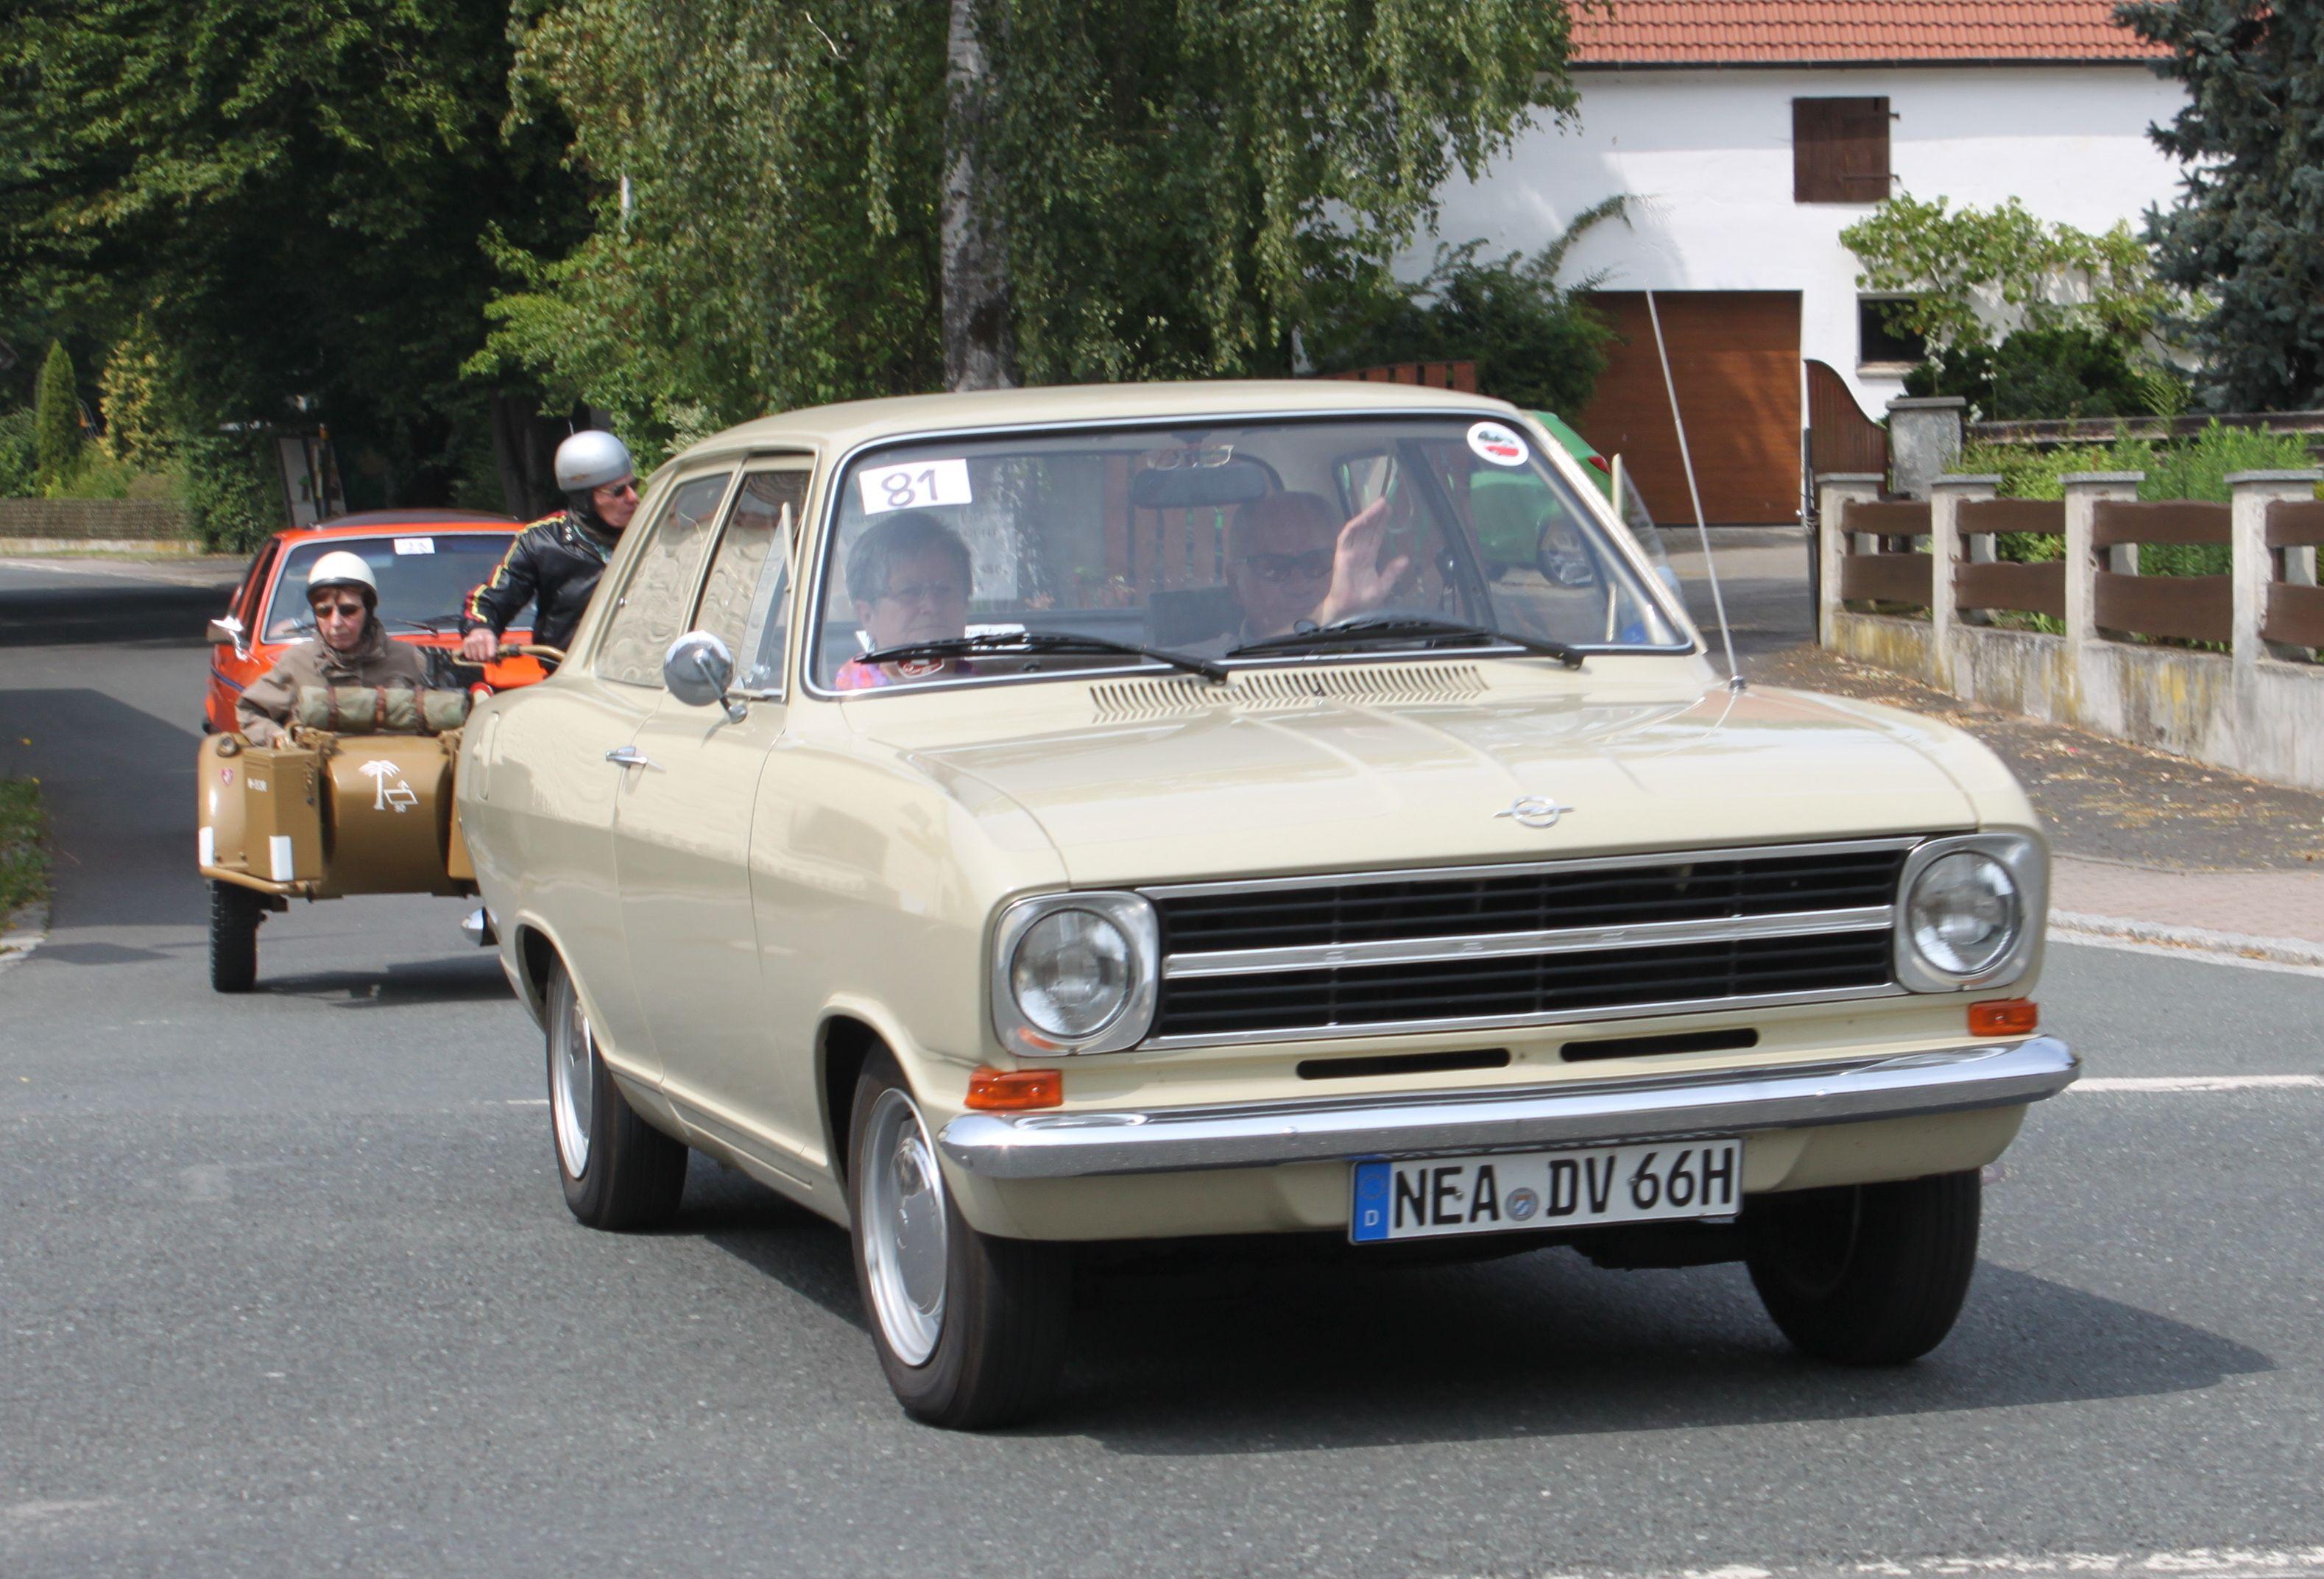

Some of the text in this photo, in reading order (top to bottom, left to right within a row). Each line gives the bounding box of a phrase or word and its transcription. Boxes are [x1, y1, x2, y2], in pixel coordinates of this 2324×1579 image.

[881, 468, 938, 506] 81
[1394, 1147, 1734, 1229] NEA DV 66H
[1364, 1209, 1380, 1227] D
